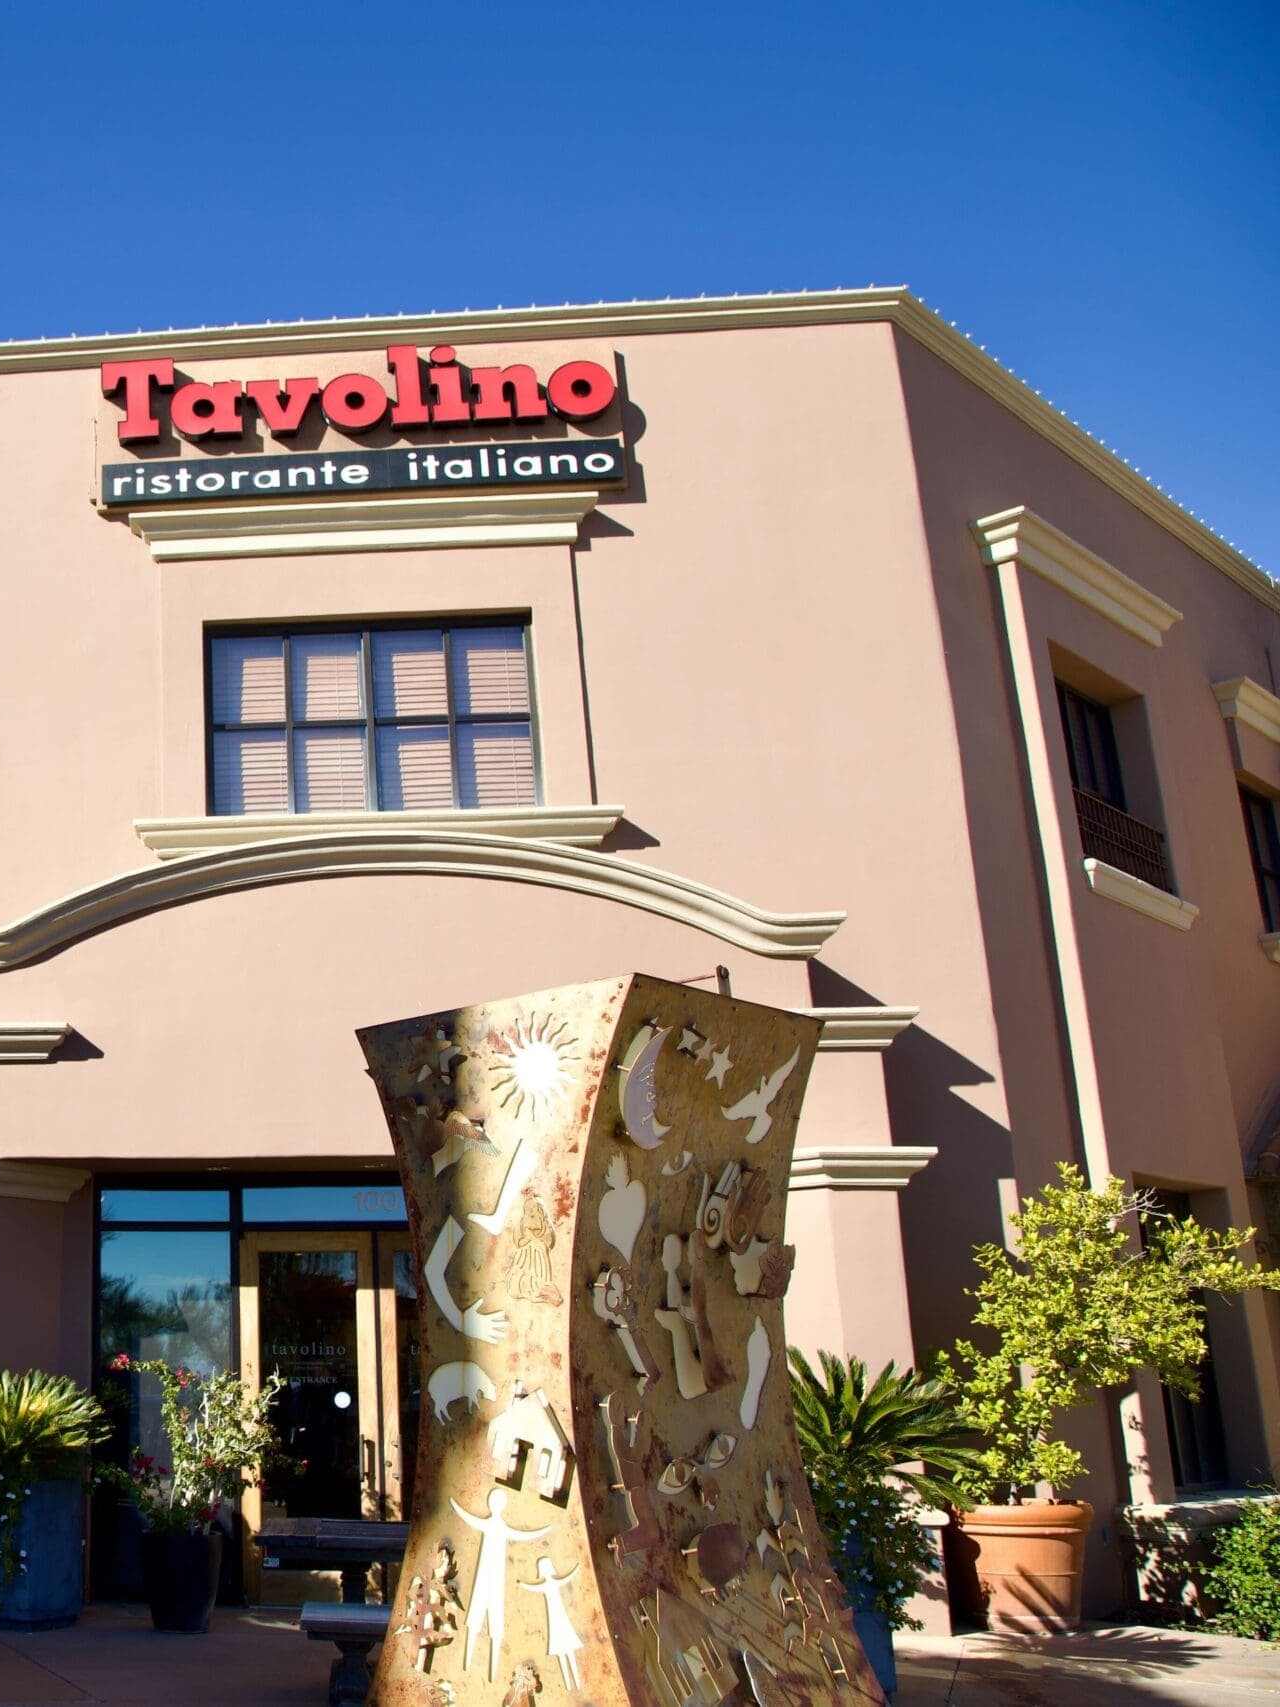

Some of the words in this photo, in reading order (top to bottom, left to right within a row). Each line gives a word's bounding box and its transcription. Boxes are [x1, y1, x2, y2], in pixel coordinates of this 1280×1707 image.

[101, 344, 616, 440] Tavolino
[113, 460, 370, 497] ristorante
[407, 448, 615, 481] italiano
[354, 1191, 399, 1212] 100
[272, 1341, 346, 1356] tavolino
